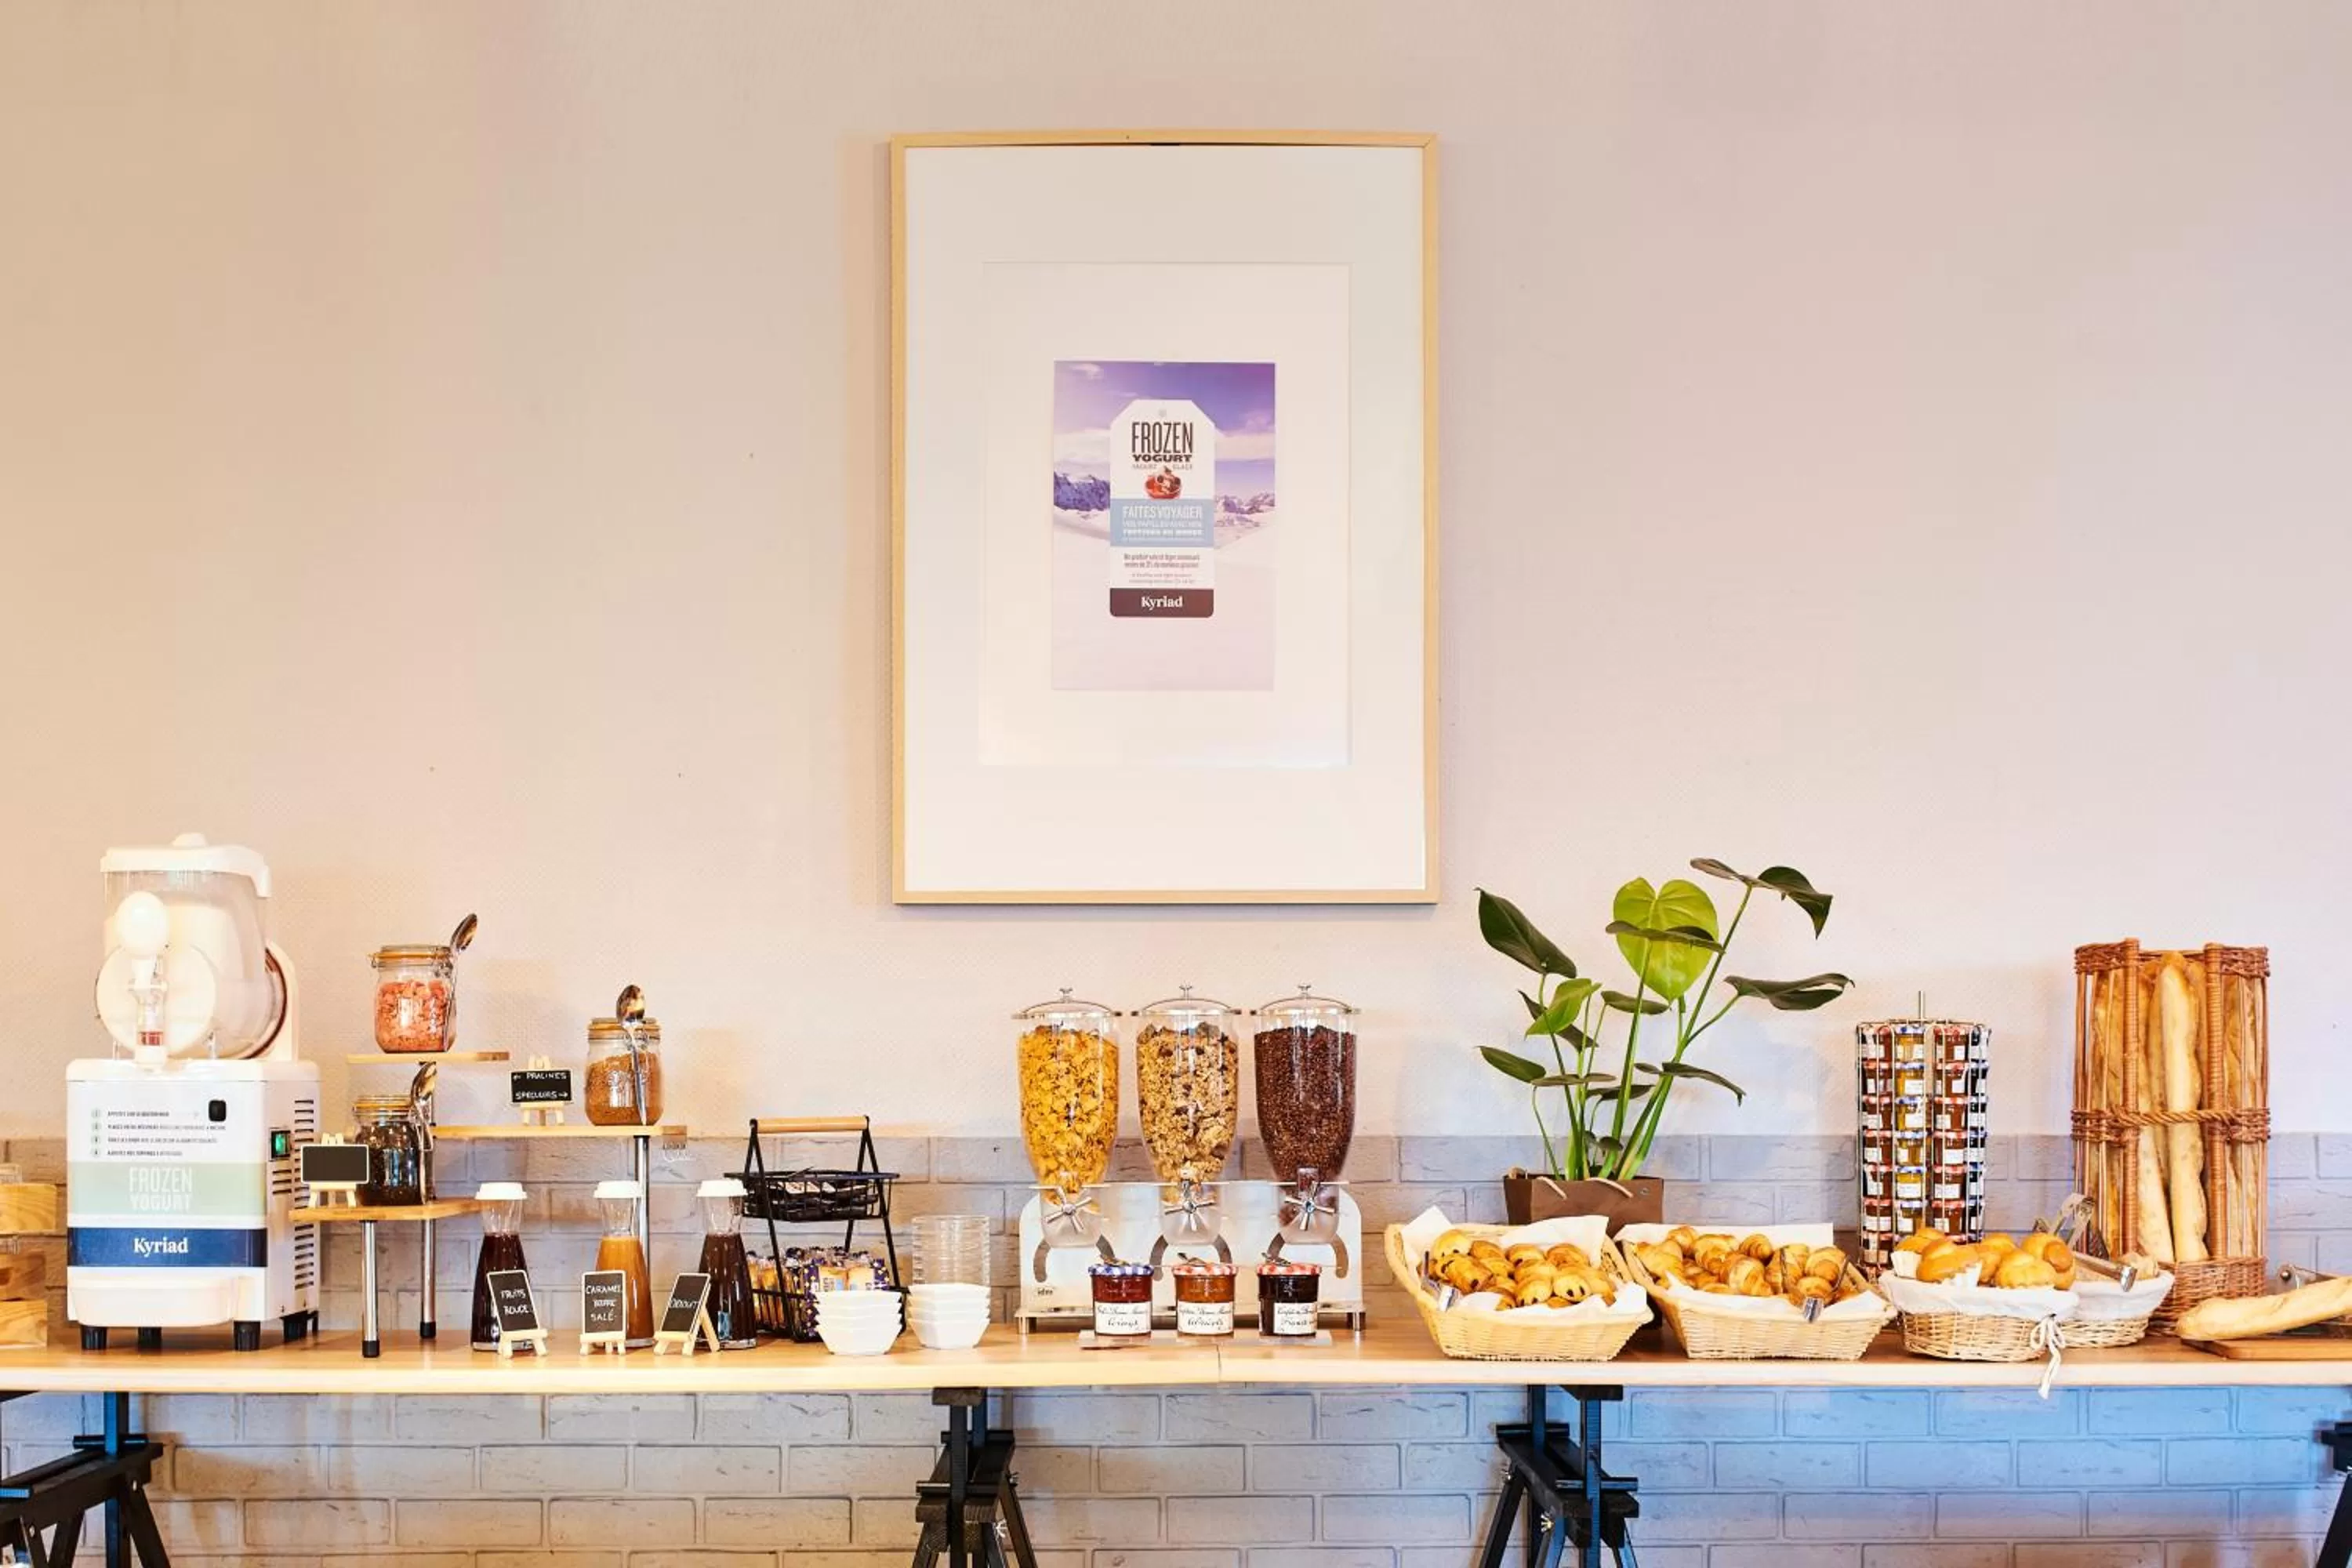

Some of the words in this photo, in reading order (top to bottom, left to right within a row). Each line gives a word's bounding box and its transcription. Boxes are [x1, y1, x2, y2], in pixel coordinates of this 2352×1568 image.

[1131, 422, 1193, 453] FROZEN
[1132, 454, 1192, 463] YOGURT
[1141, 596, 1183, 611] Kyriad
[129, 1167, 193, 1192] FROZEN
[129, 1193, 191, 1211] YOGURT
[133, 1237, 189, 1258] Kyriad
